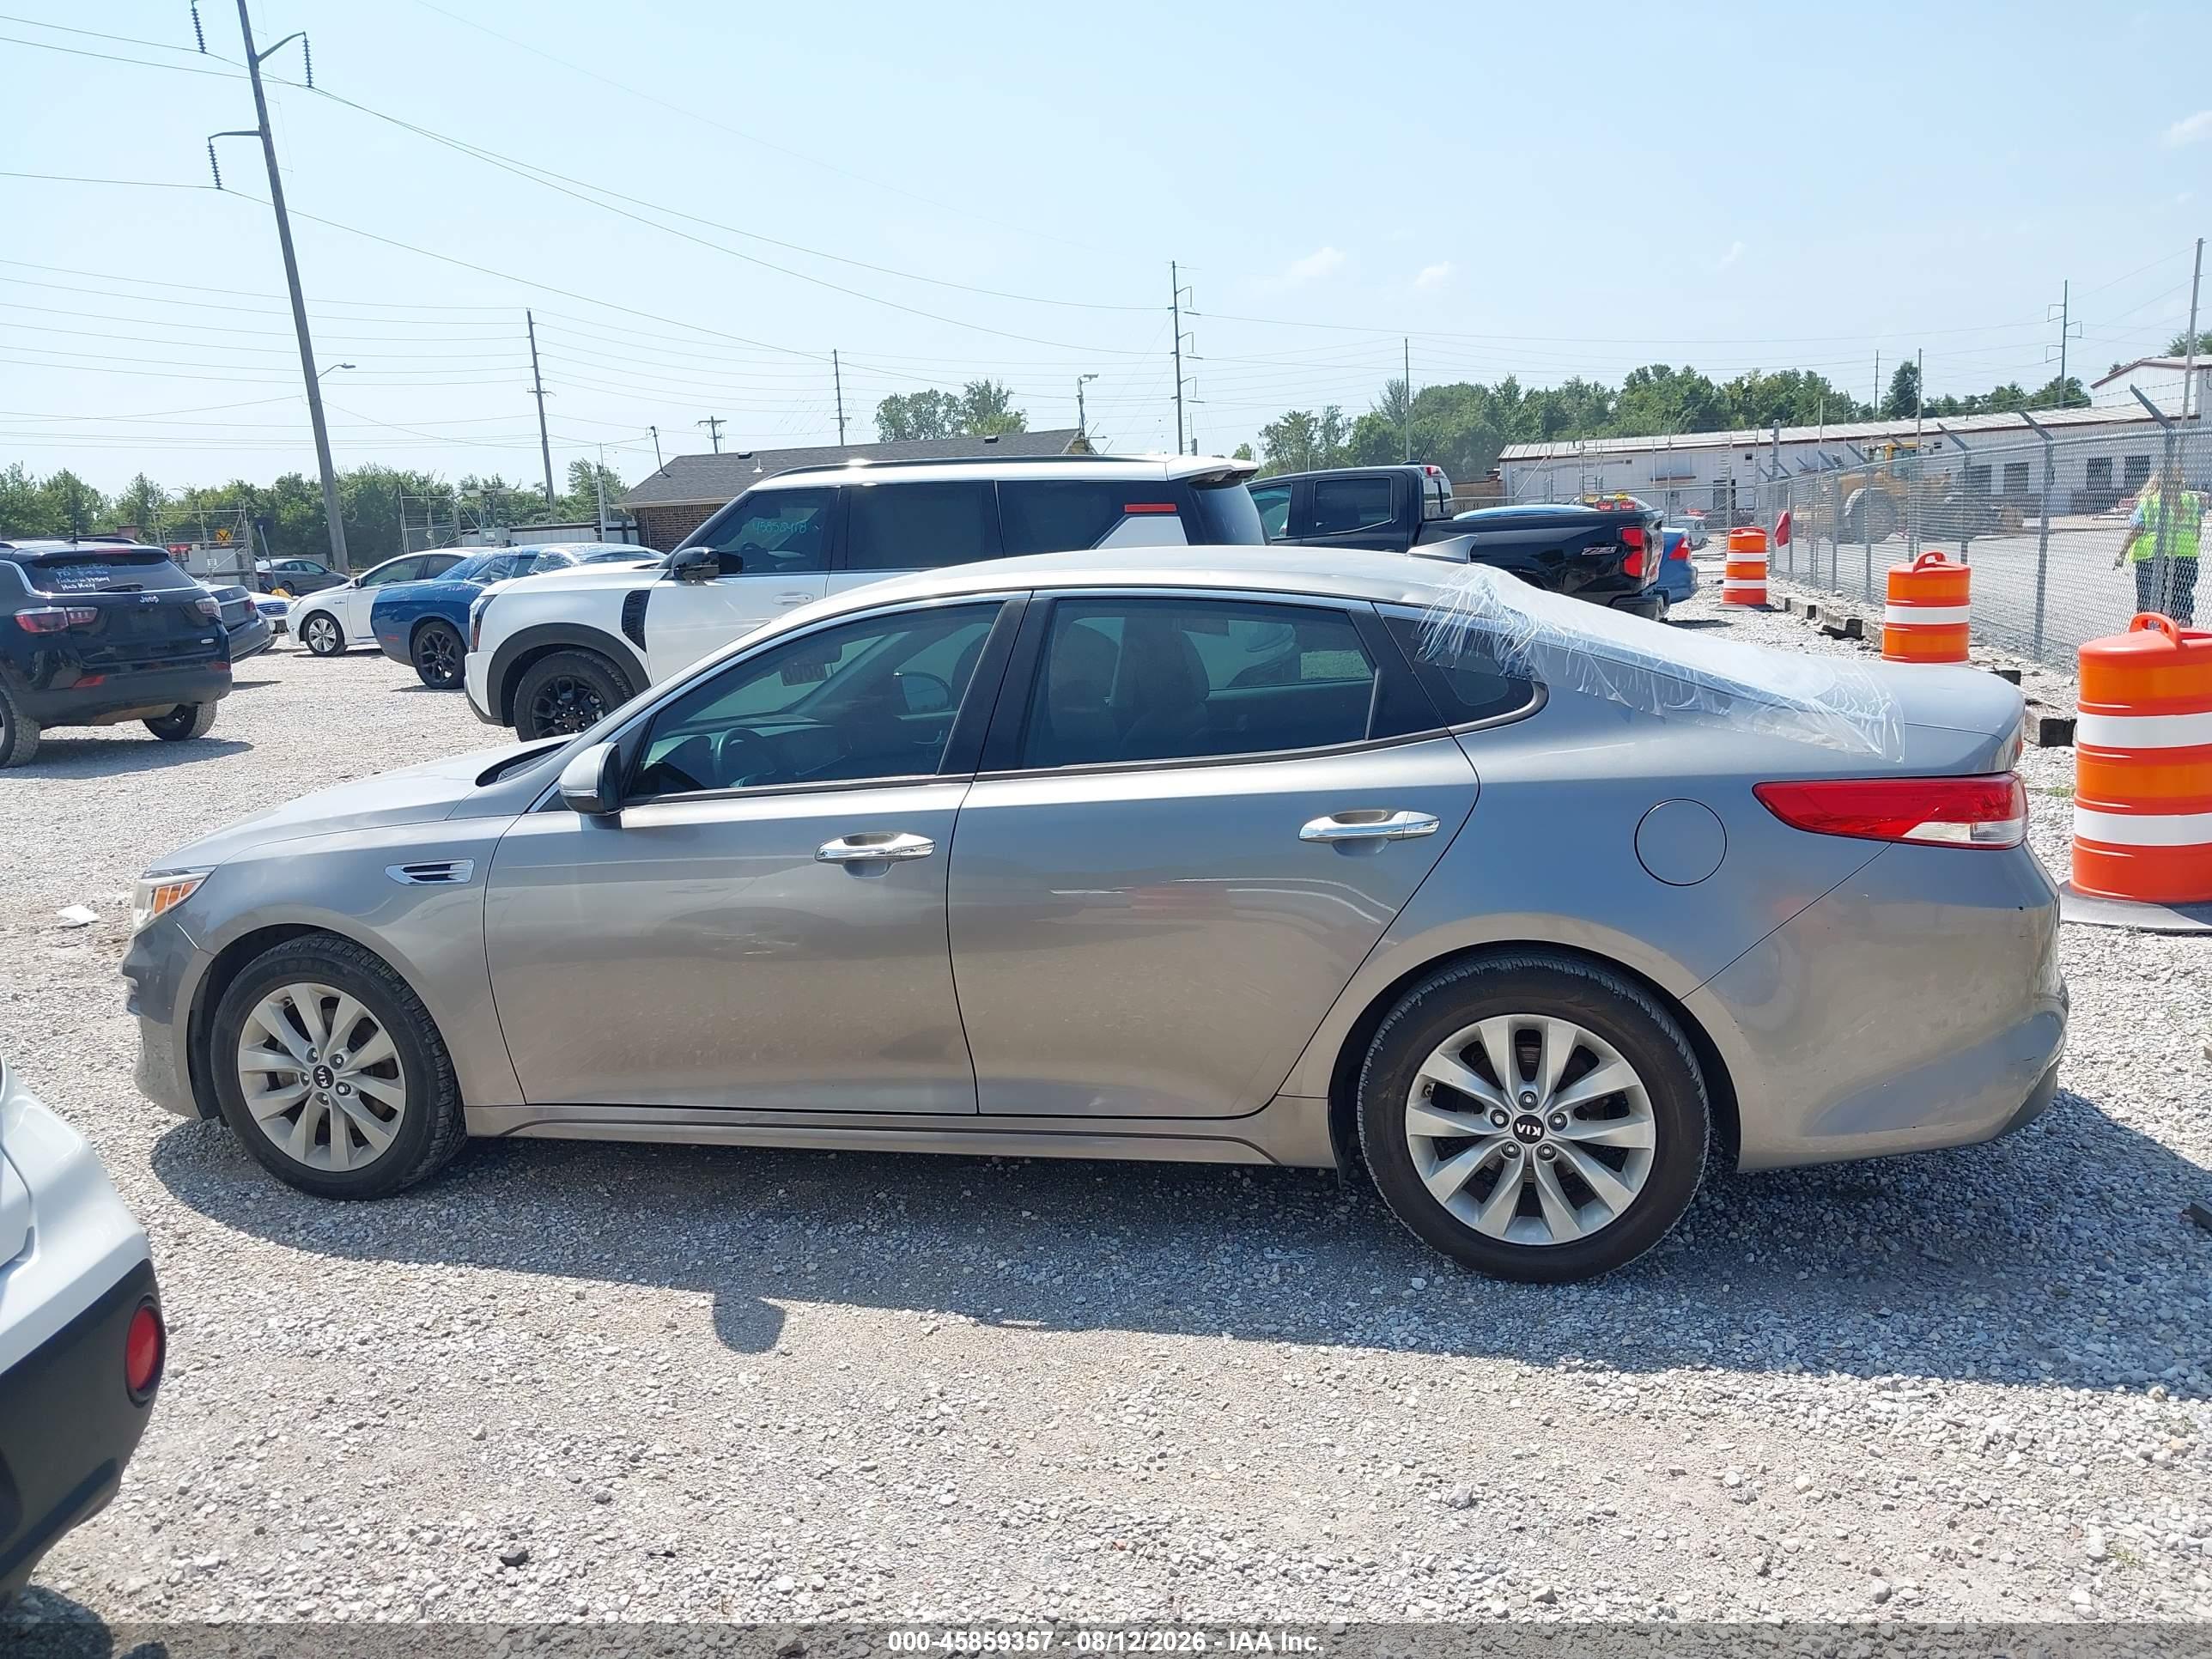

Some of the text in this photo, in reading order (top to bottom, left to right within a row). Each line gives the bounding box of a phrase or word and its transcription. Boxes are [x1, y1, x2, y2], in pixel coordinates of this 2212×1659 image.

[1582, 546, 1617, 556] Z71
[139, 595, 160, 604] Jeep
[318, 1066, 329, 1087] KIA
[1516, 1123, 1541, 1137] KIA
